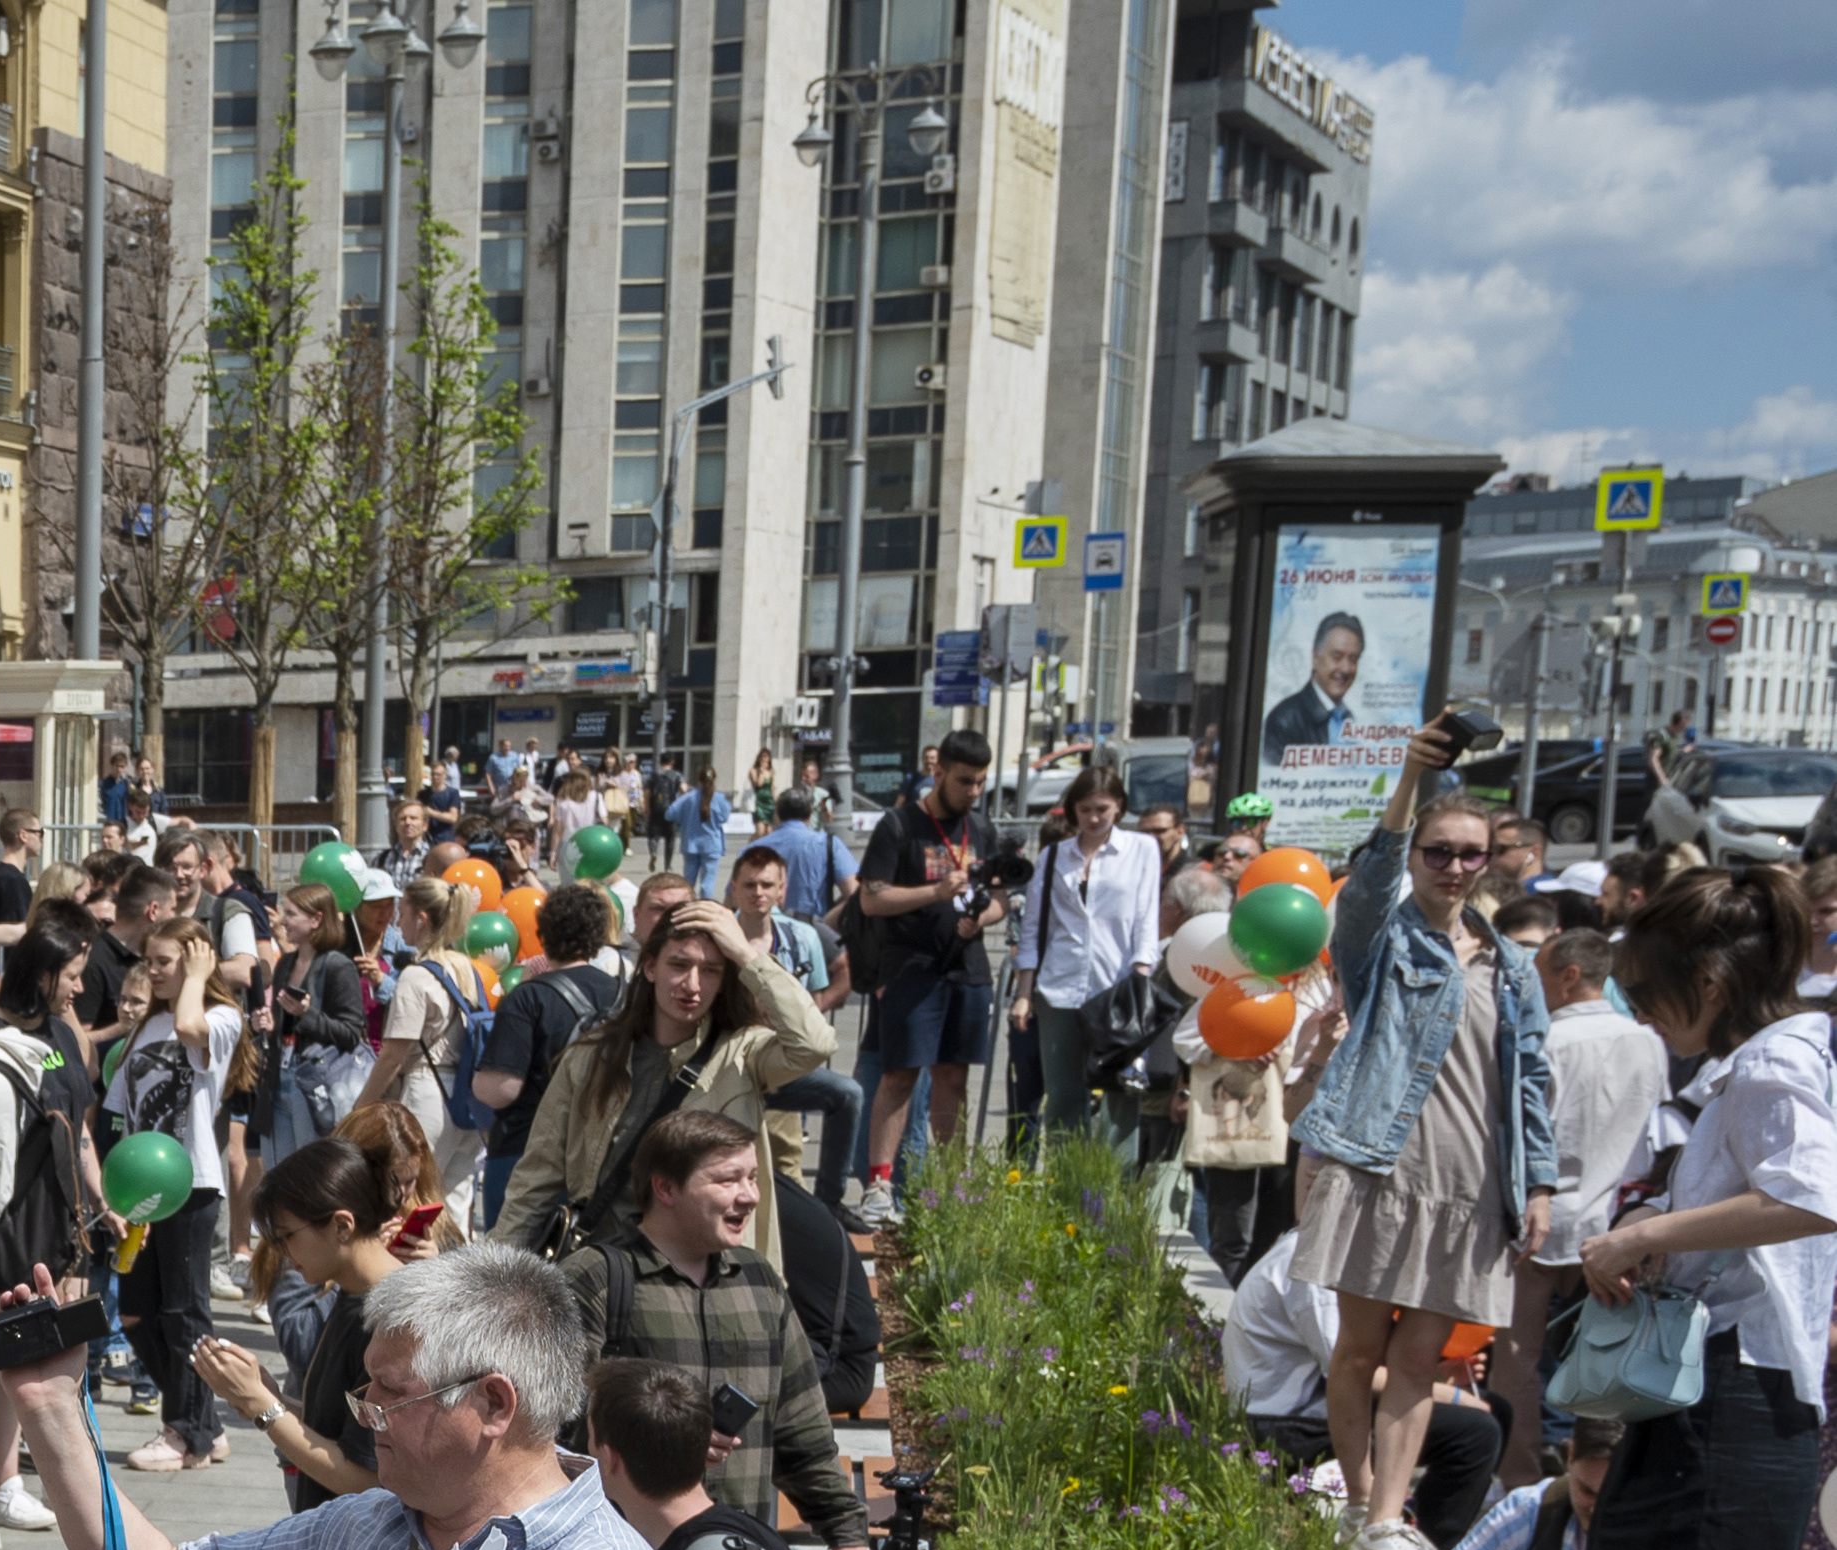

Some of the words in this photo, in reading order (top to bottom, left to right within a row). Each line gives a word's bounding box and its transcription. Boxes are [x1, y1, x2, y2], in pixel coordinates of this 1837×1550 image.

[1280, 569, 1299, 584] 26
[1304, 569, 1356, 584] ИЮНЯ
[1341, 721, 1415, 741] Андрею
[1282, 747, 1404, 771] ДЕМЕНТЬЕВ
